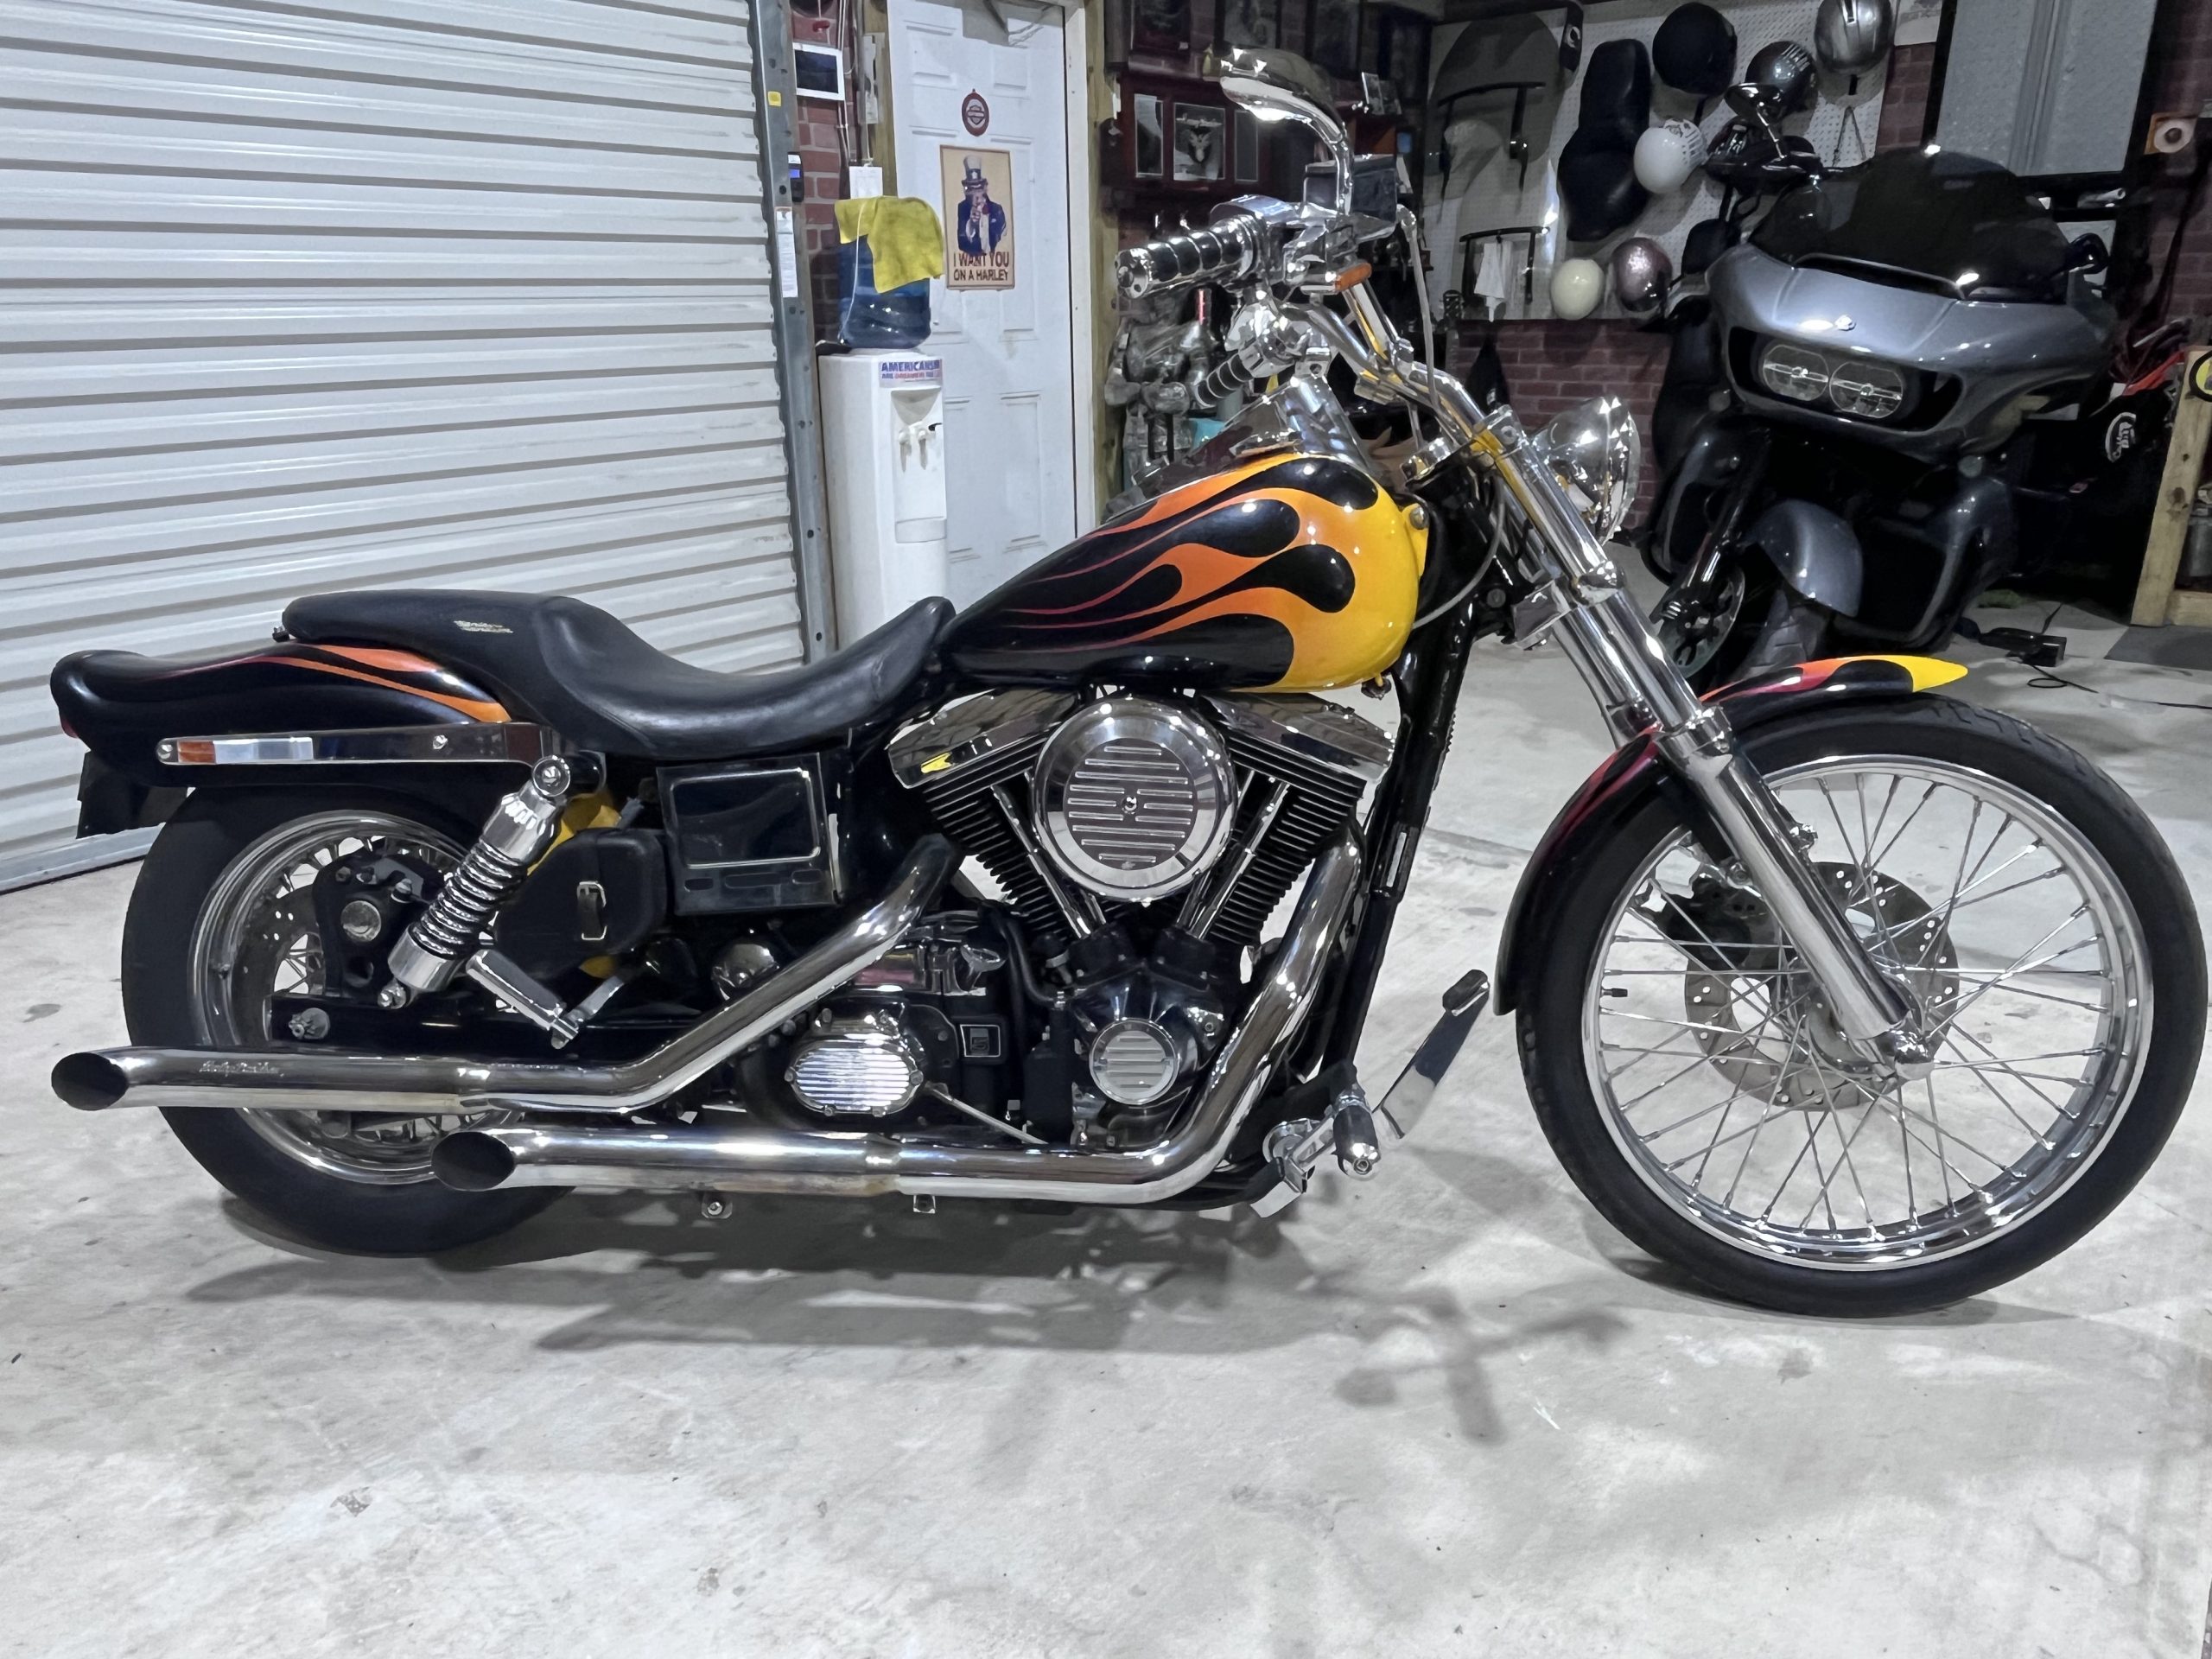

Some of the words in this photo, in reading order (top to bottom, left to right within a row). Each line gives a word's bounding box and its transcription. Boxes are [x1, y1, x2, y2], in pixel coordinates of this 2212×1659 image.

[953, 252, 957, 267] I
[958, 253, 986, 267] WANT
[989, 251, 1009, 267] YOU
[953, 269, 966, 281] ON
[968, 270, 975, 281] A
[976, 269, 1008, 281] HARLEY
